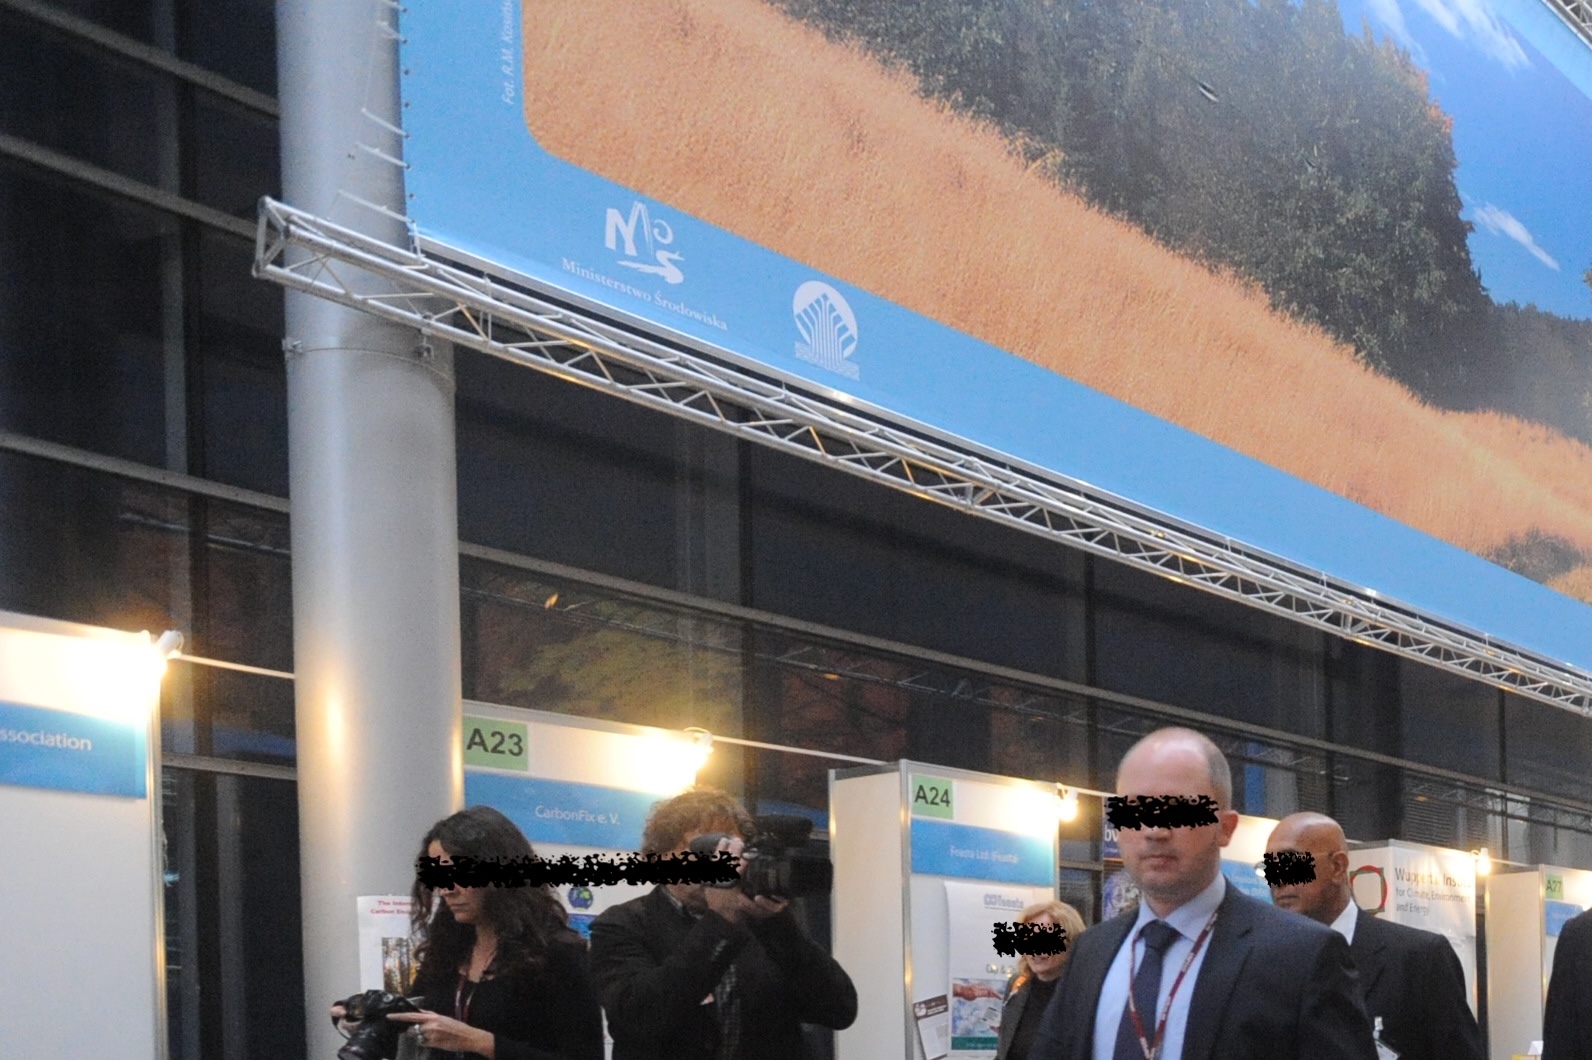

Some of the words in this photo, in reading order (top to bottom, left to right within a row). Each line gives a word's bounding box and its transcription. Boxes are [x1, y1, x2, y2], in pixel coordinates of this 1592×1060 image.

[561, 257, 652, 302] Ministerstwo
[654, 289, 728, 332] Środowiska
[466, 728, 524, 757] A23
[914, 784, 951, 808] A24
[534, 804, 595, 823] CarbonFix
[1396, 886, 1406, 897] for
[1546, 879, 1562, 893] A27
[1396, 903, 1409, 912] and
